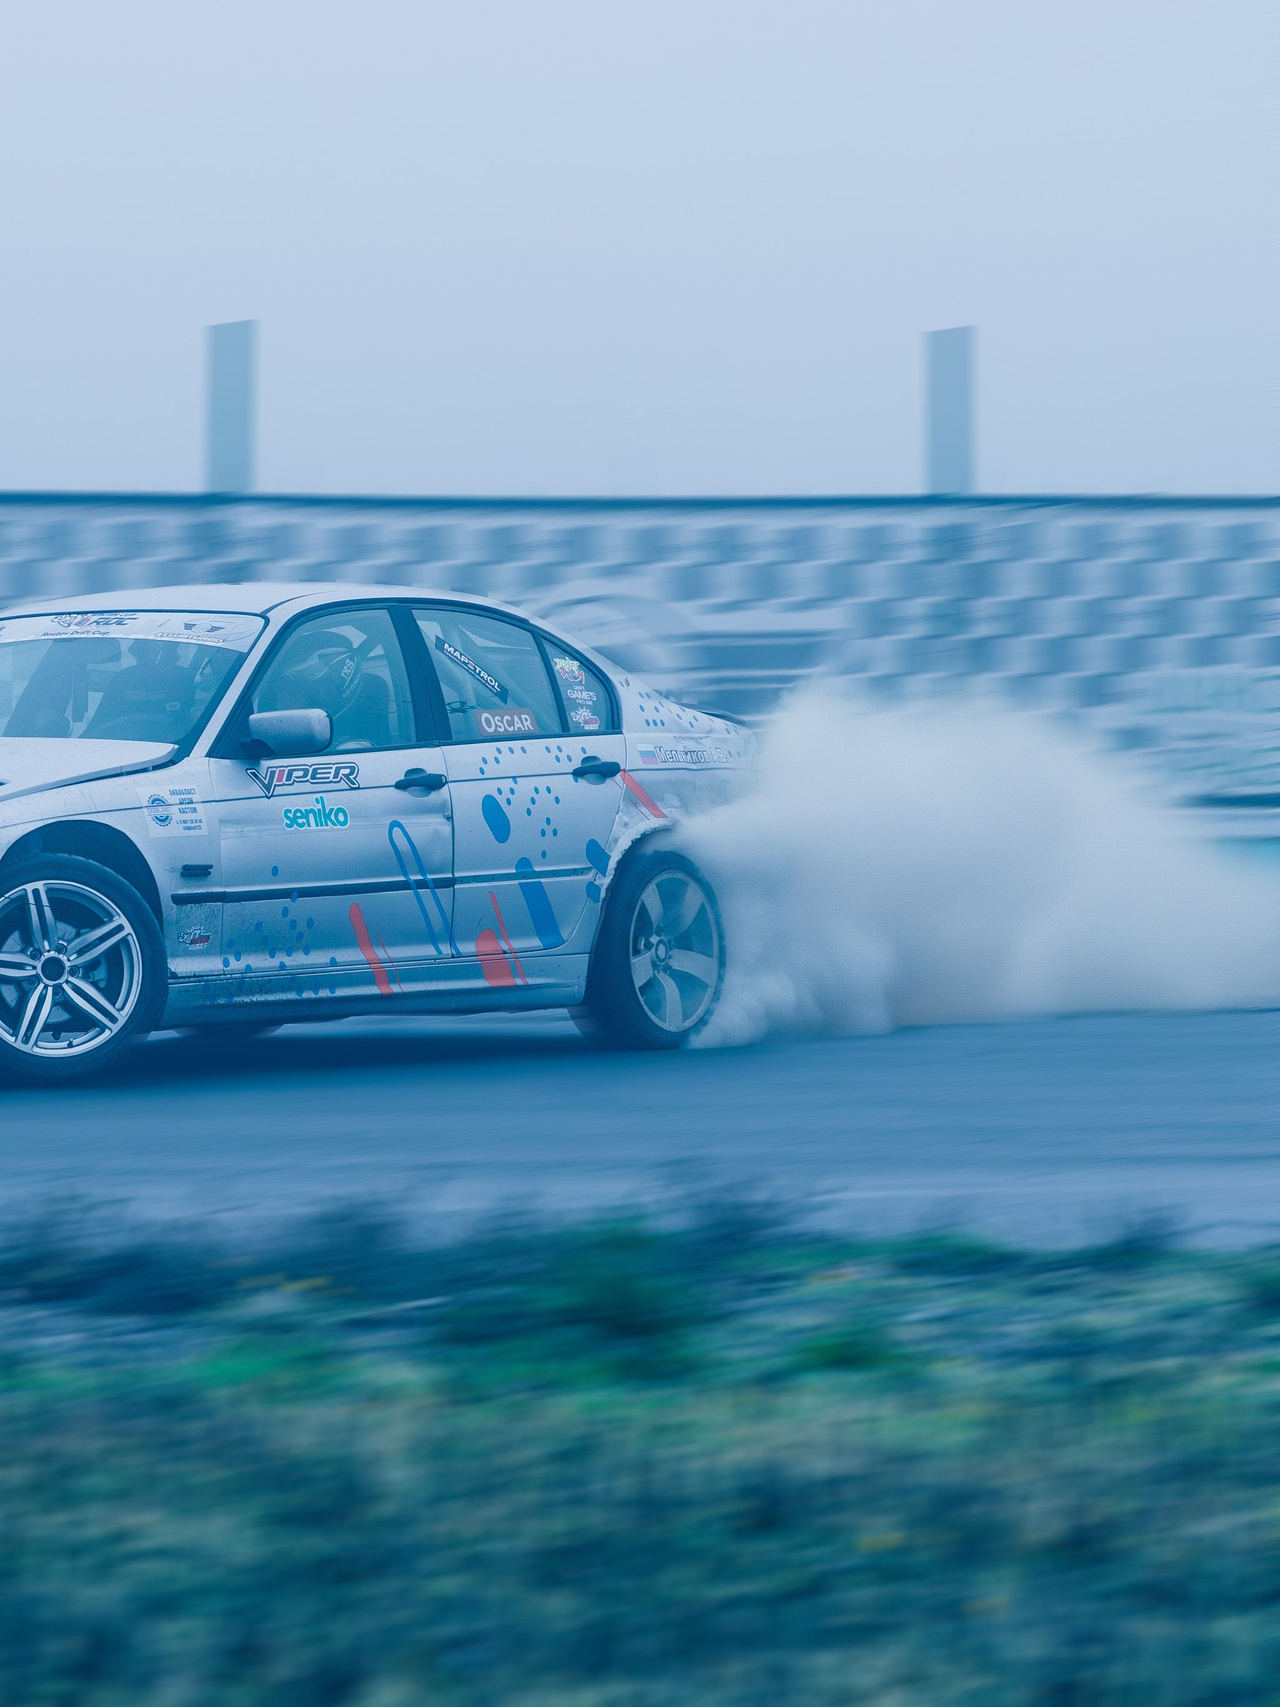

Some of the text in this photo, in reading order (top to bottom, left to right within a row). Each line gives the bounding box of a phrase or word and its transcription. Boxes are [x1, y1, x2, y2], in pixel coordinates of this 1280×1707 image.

[443, 642, 501, 692] MAPETROL
[245, 761, 361, 800] VIPER
[283, 795, 349, 829] seniko
